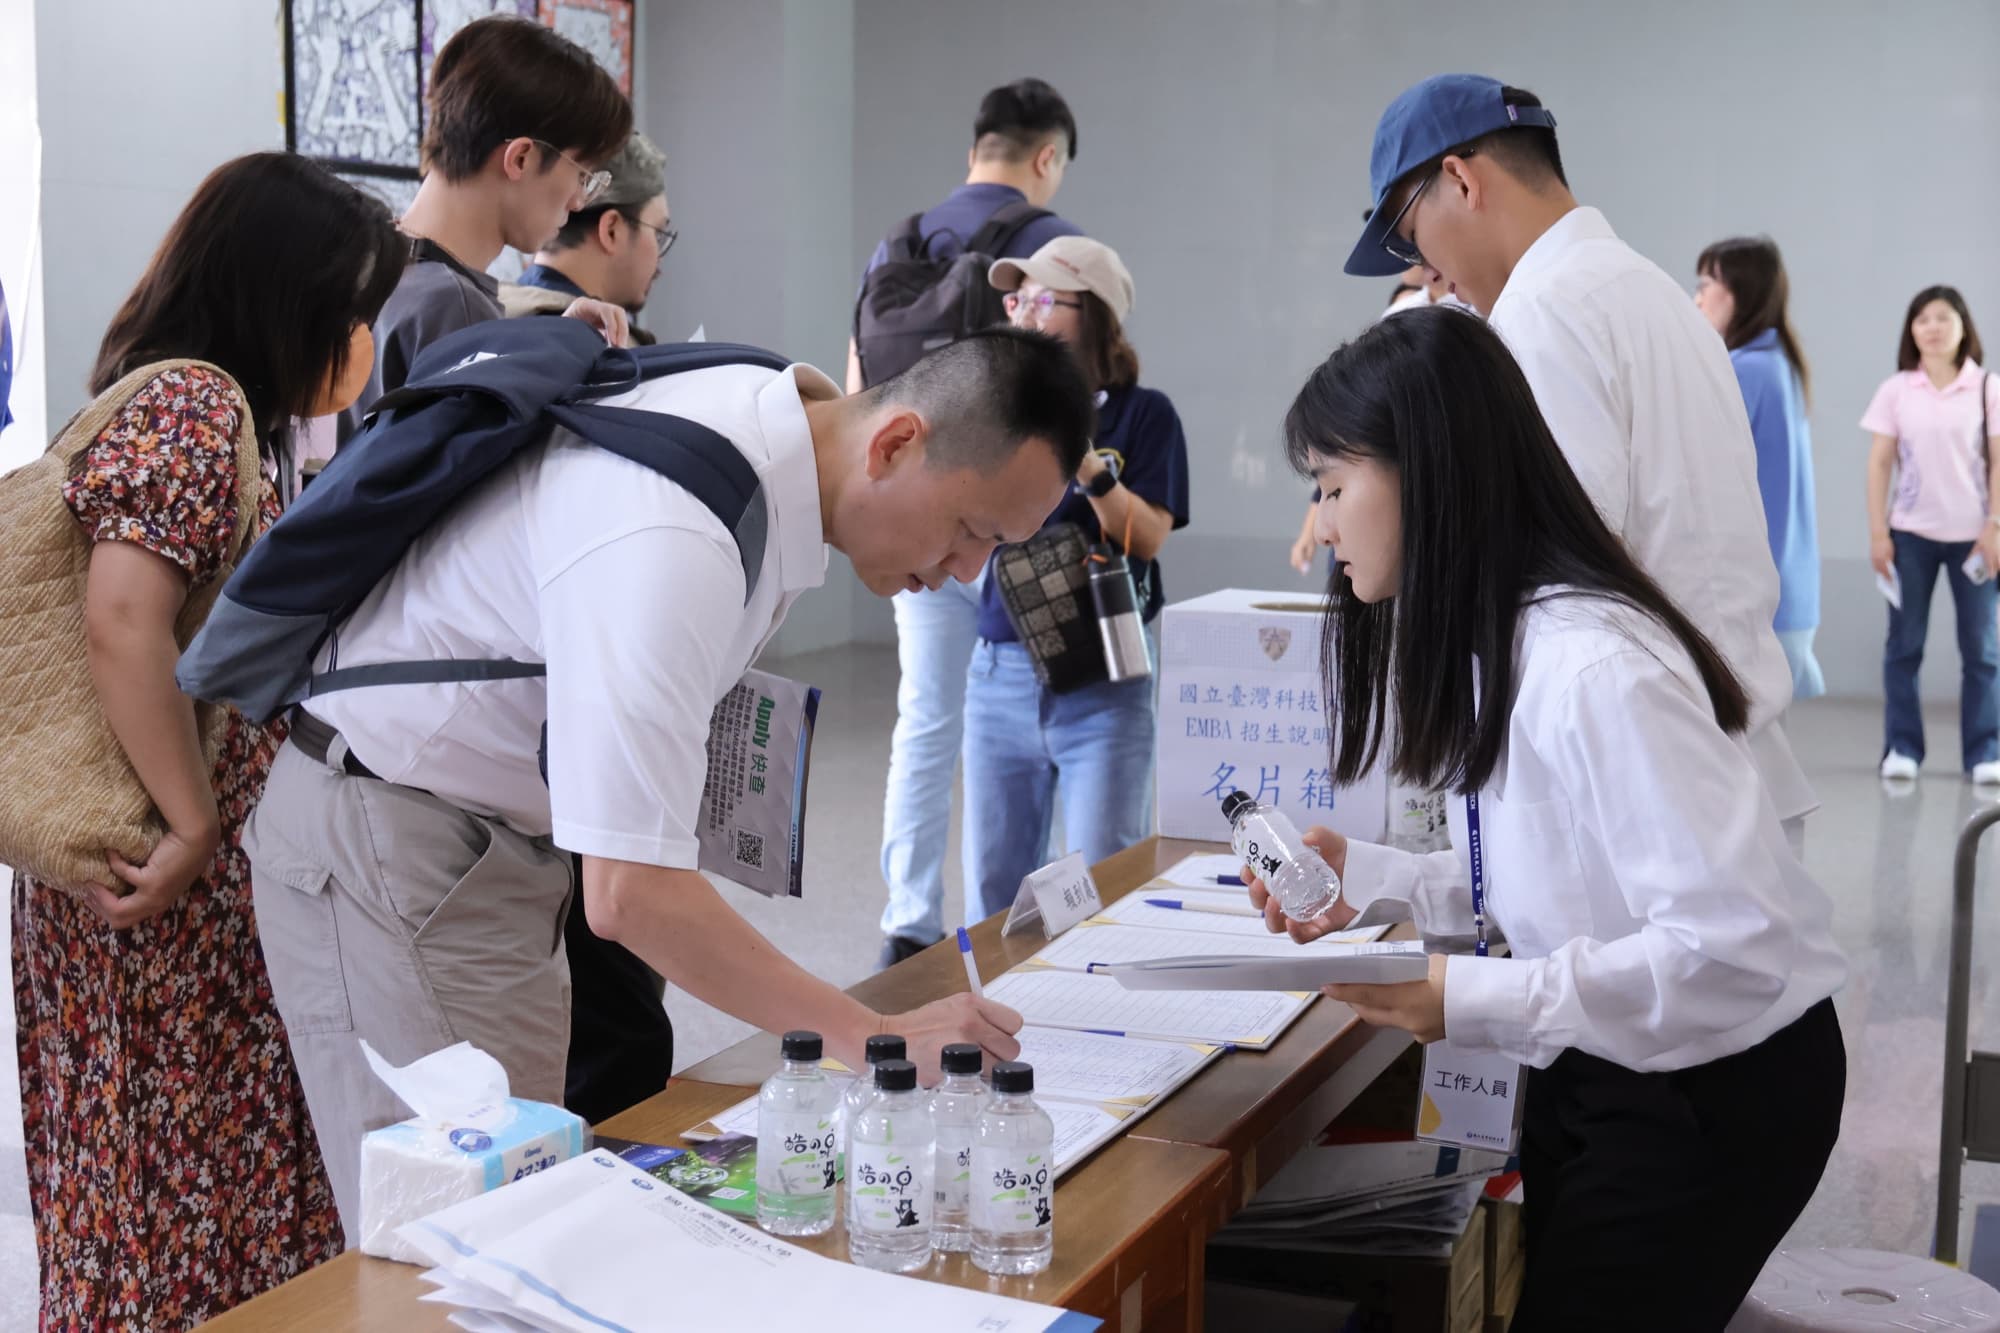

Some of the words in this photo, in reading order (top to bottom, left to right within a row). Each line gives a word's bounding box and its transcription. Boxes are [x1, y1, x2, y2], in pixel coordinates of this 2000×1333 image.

[1180, 683, 1341, 713] 國立臺灣科技
[752, 696, 775, 749] Apply
[1186, 717, 1232, 740] EMBA
[748, 754, 768, 796] 快查
[1202, 761, 1335, 810] 名片箱
[1434, 1070, 1508, 1099] 工作人員
